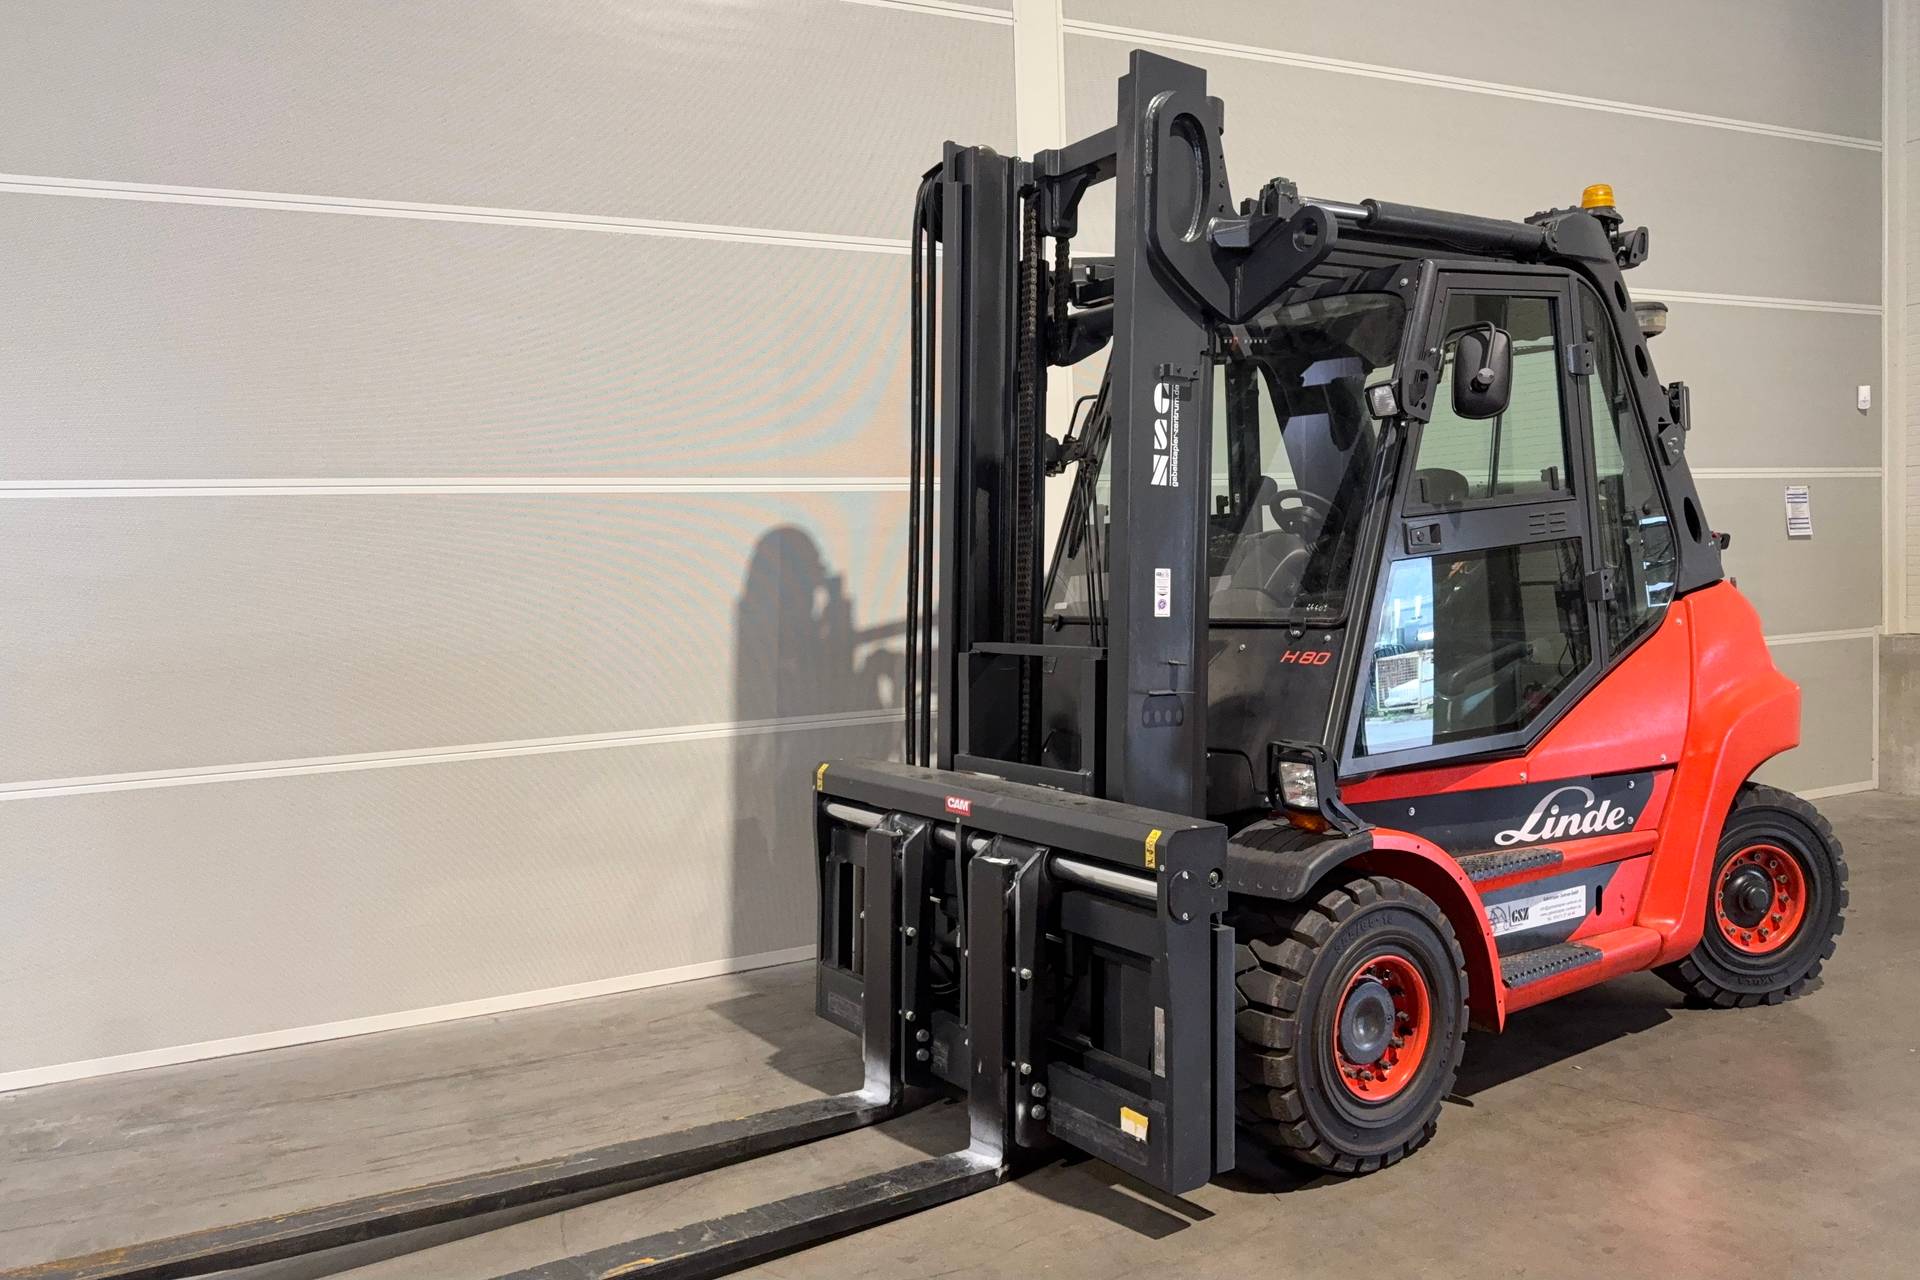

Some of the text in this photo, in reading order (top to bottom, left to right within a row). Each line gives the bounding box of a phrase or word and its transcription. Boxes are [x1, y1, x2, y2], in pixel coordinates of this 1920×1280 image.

[1151, 382, 1170, 486] GSZ
[947, 797, 970, 812] CAM
[1494, 786, 1625, 846] Linde
[1511, 906, 1530, 923] GSZ
